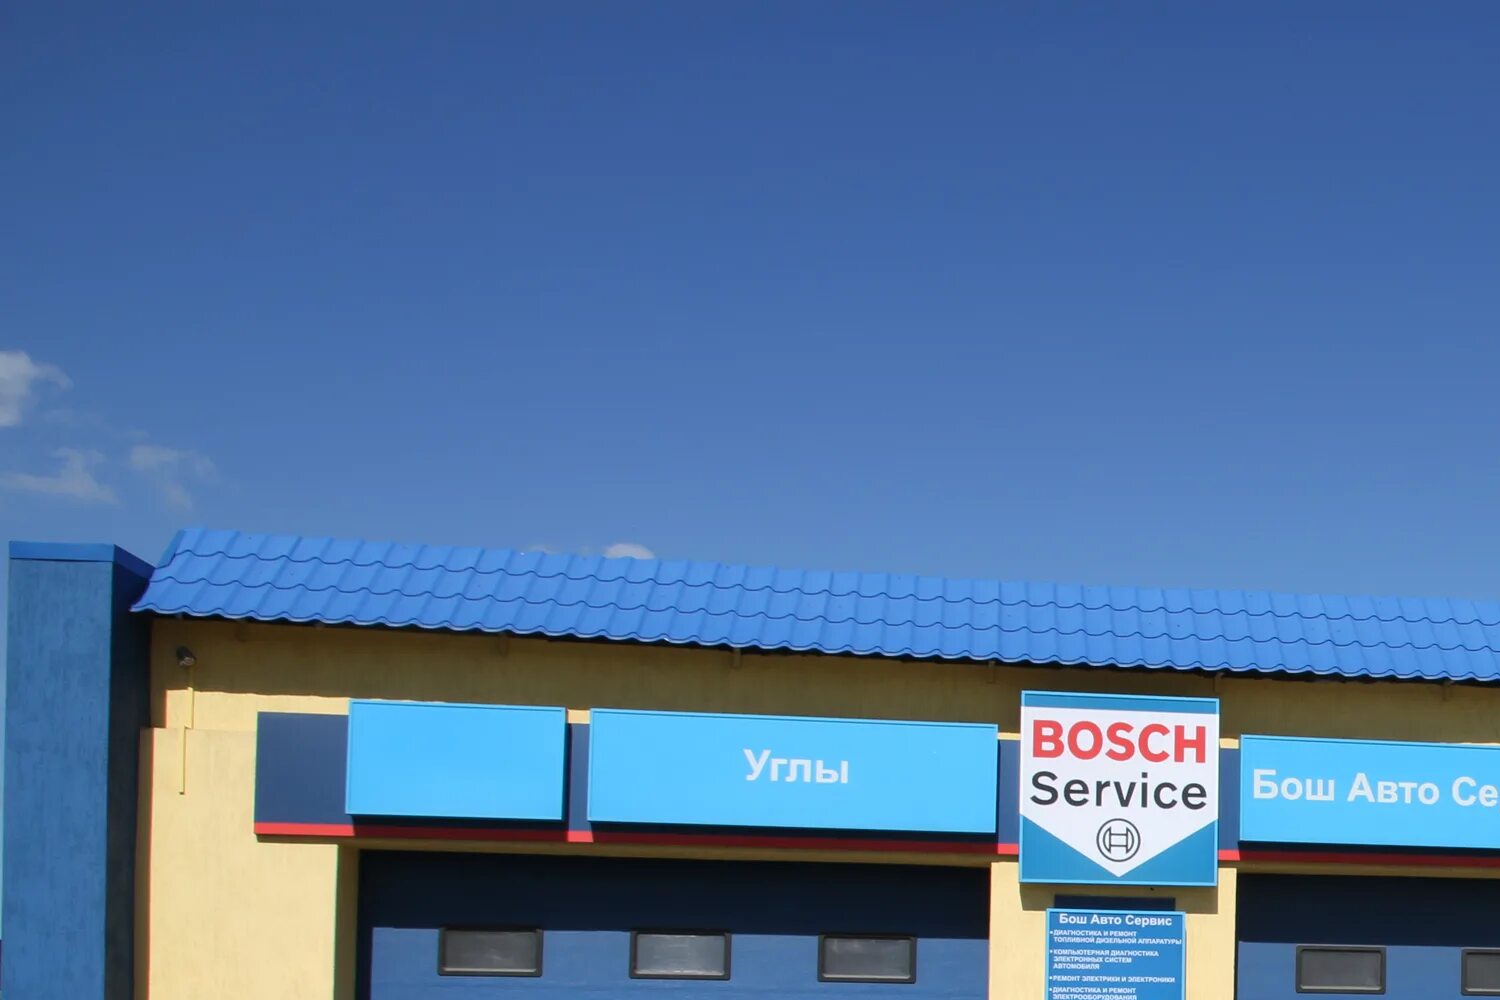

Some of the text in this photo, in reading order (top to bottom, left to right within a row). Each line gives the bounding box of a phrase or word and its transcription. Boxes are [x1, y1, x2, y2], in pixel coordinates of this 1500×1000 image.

[1032, 720, 1206, 763] BOSCH
[742, 748, 850, 785] Углы
[1030, 770, 1207, 810] Service
[1252, 768, 1335, 802] Бош
[1346, 773, 1439, 805] Авто
[1059, 914, 1172, 927] Бош Авто Сервис
